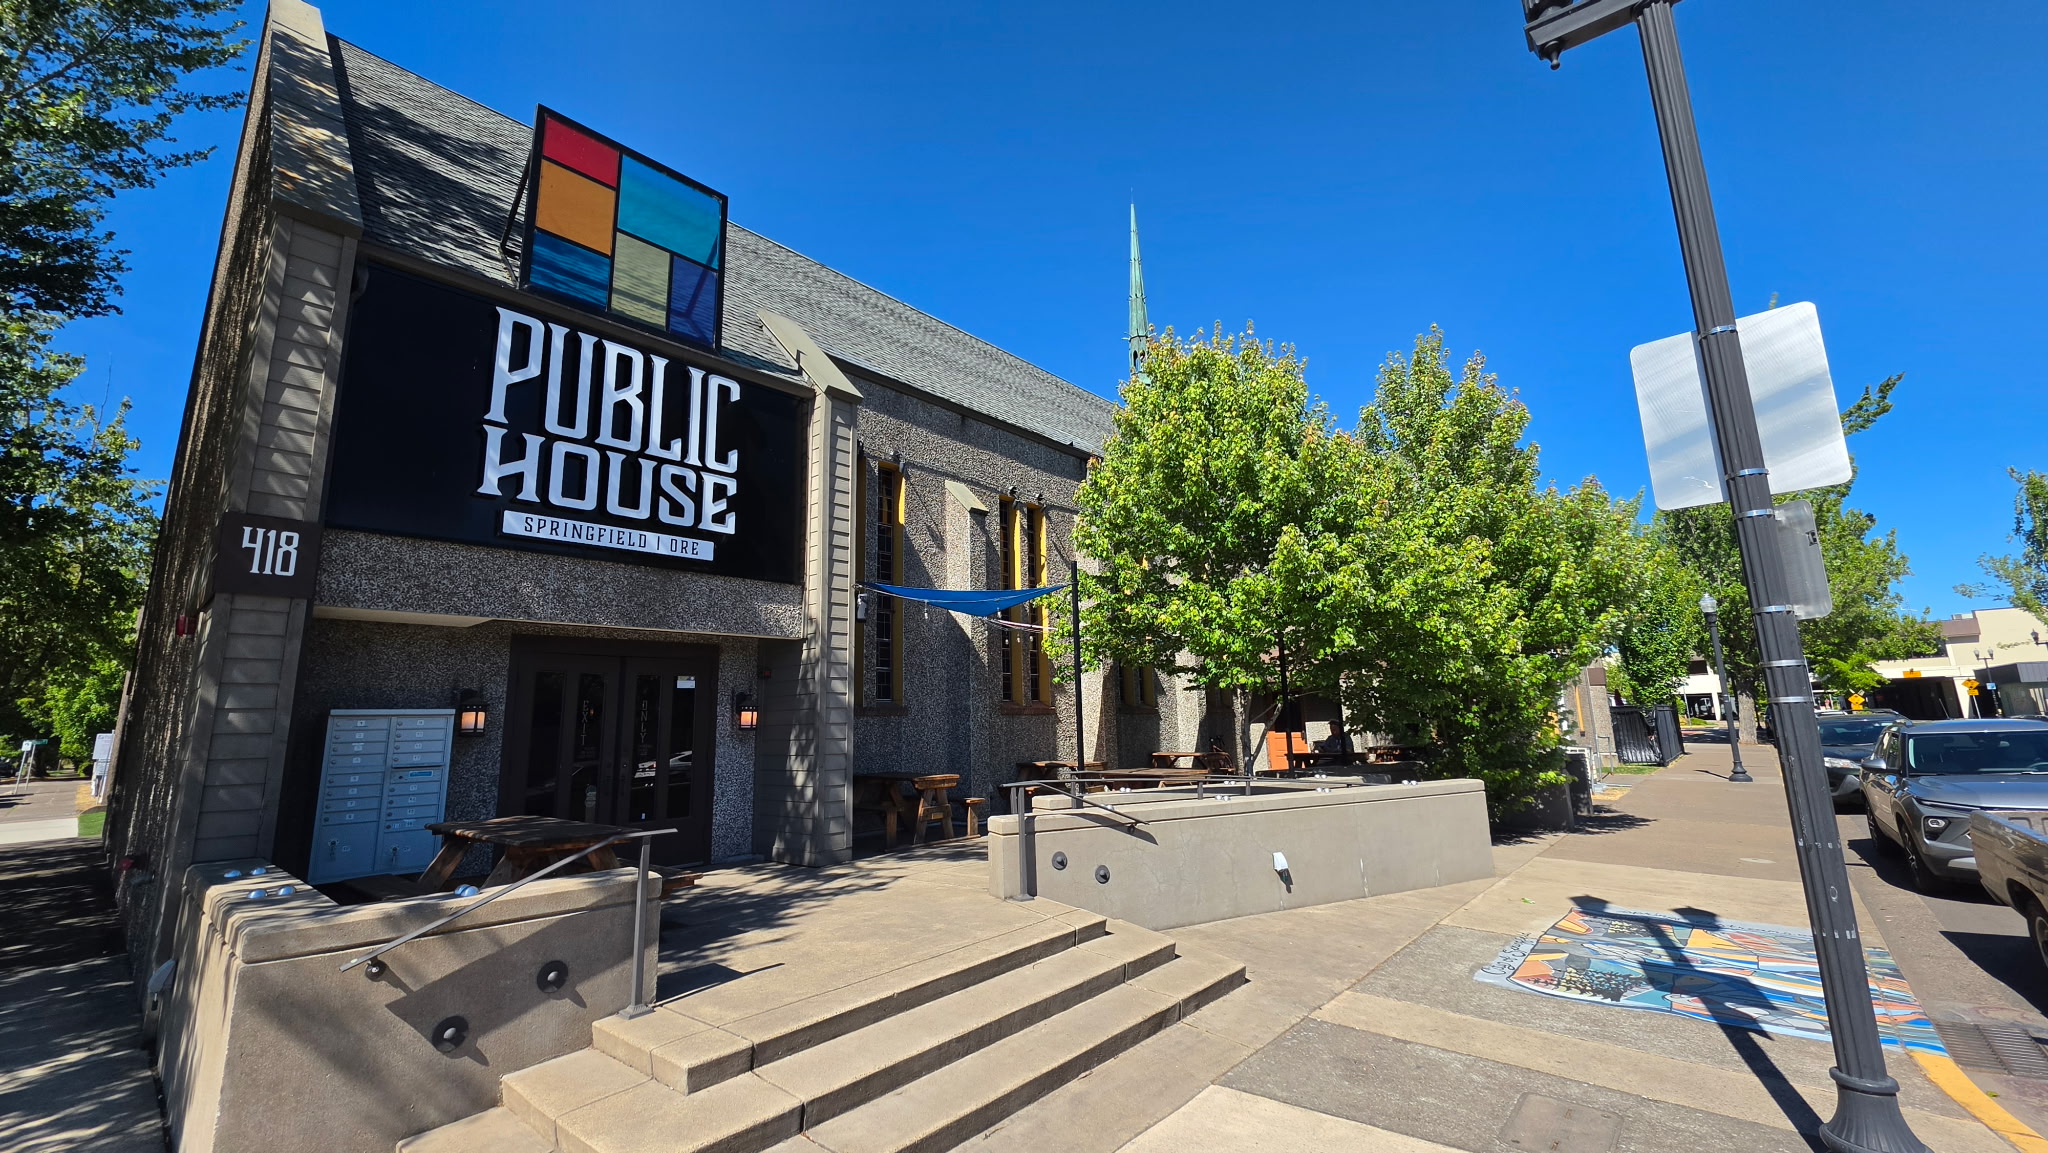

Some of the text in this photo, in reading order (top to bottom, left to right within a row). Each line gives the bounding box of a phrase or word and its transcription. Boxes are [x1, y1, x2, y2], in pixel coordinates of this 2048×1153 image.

[483, 306, 741, 473] PUBLIC
[476, 424, 737, 535] HOUSE
[242, 526, 300, 577] 418
[524, 516, 647, 548] SPRINGFIELD
[669, 537, 699, 556] ORE
[580, 700, 590, 746] EXIT
[639, 700, 649, 744] ONLY
